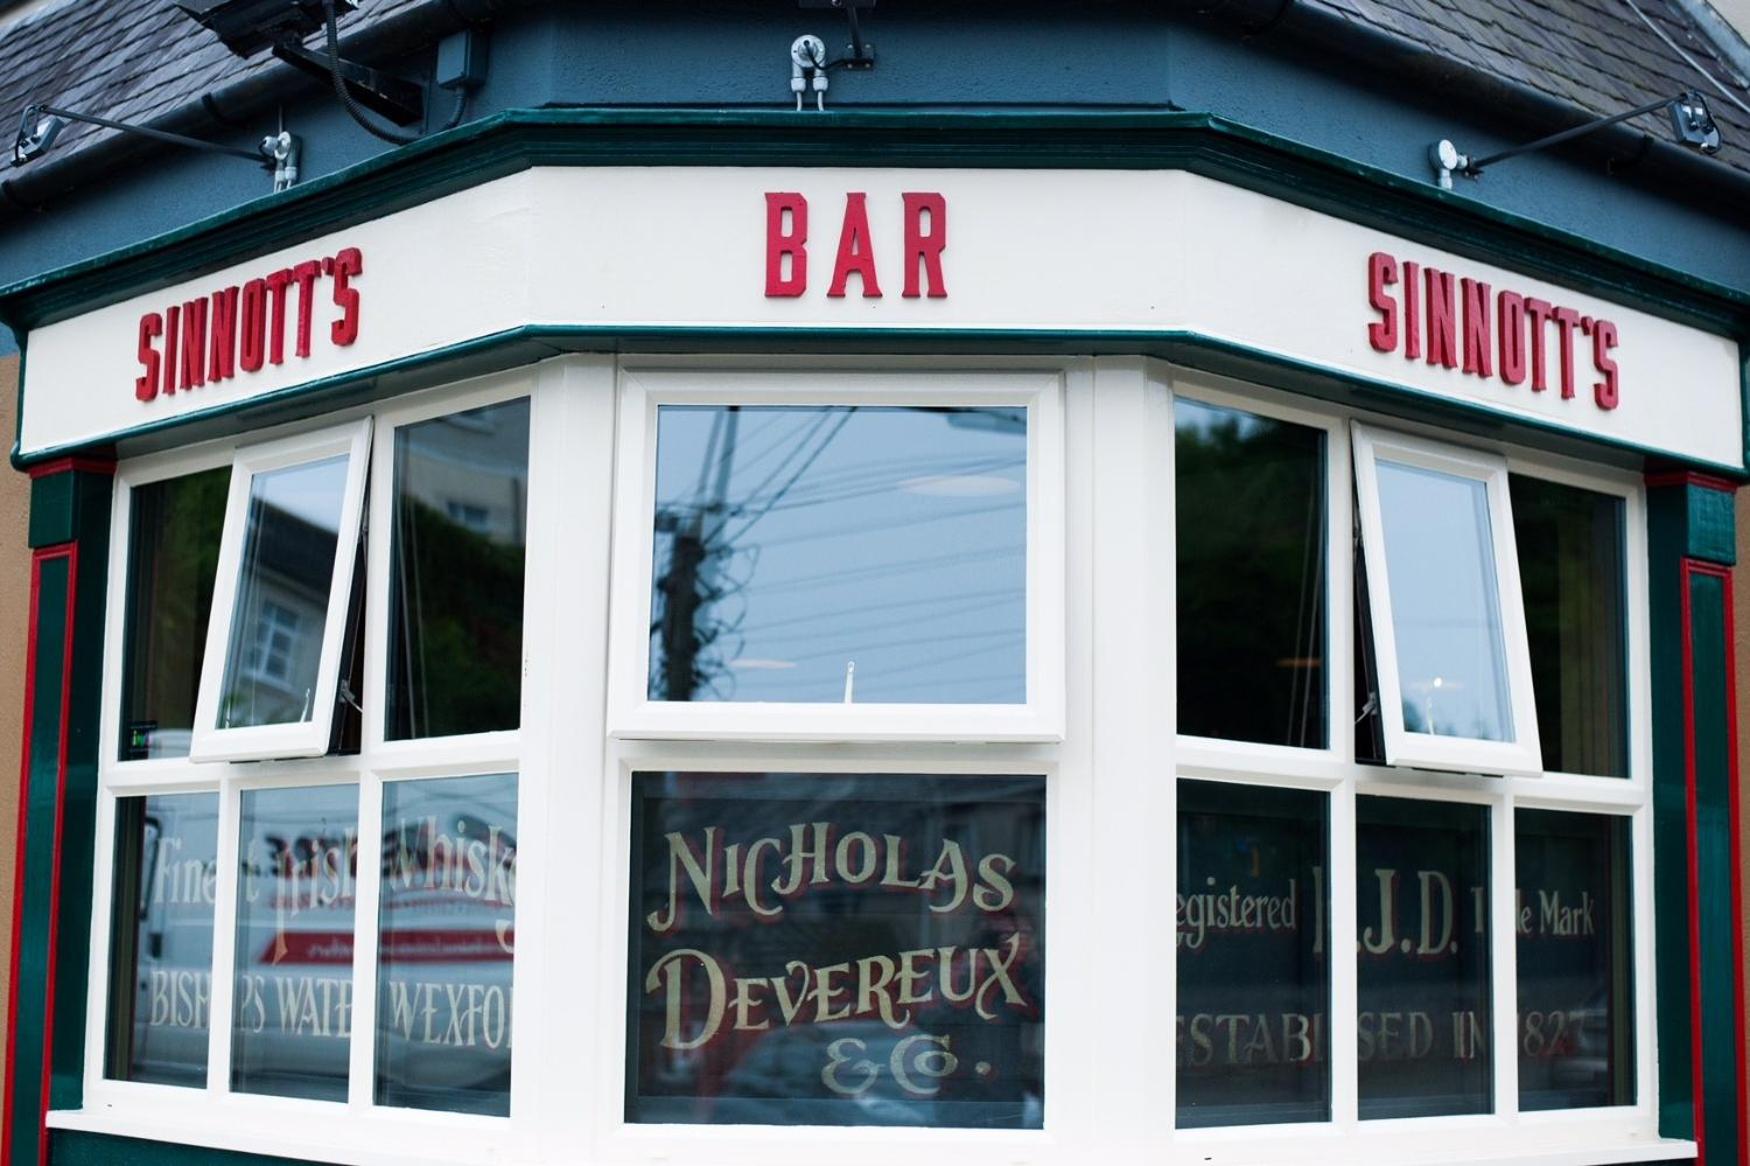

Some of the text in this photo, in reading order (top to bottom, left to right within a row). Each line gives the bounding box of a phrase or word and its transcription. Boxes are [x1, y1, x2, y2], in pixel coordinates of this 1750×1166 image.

[765, 192, 947, 298] BAR
[136, 247, 362, 402] SINNOTT'S
[1368, 252, 1618, 410] SINNOTT'S
[153, 836, 260, 904] Finet
[647, 822, 1016, 932] NICHOLAS
[1176, 876, 1297, 948] egistered
[1538, 890, 1595, 936] Mark
[150, 970, 266, 1033] BISHPS
[275, 976, 353, 1038] WATE
[645, 932, 1028, 1051] DEVEREUX
